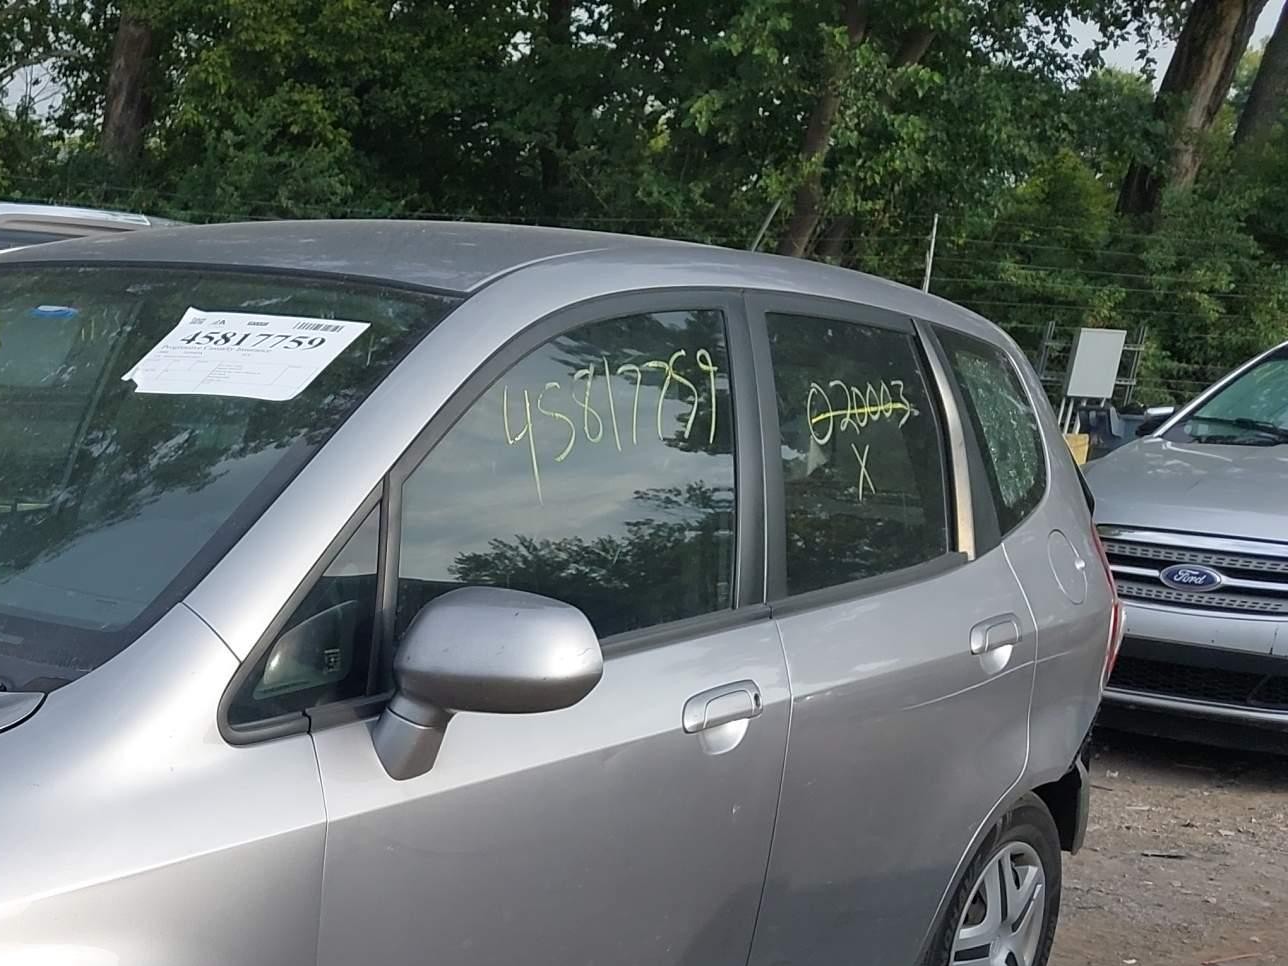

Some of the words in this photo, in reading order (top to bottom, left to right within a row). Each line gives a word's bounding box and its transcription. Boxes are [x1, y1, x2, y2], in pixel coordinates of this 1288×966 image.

[180, 330, 327, 351] 45817759
[503, 348, 718, 505] 45817759
[1173, 568, 1208, 585] Ford
